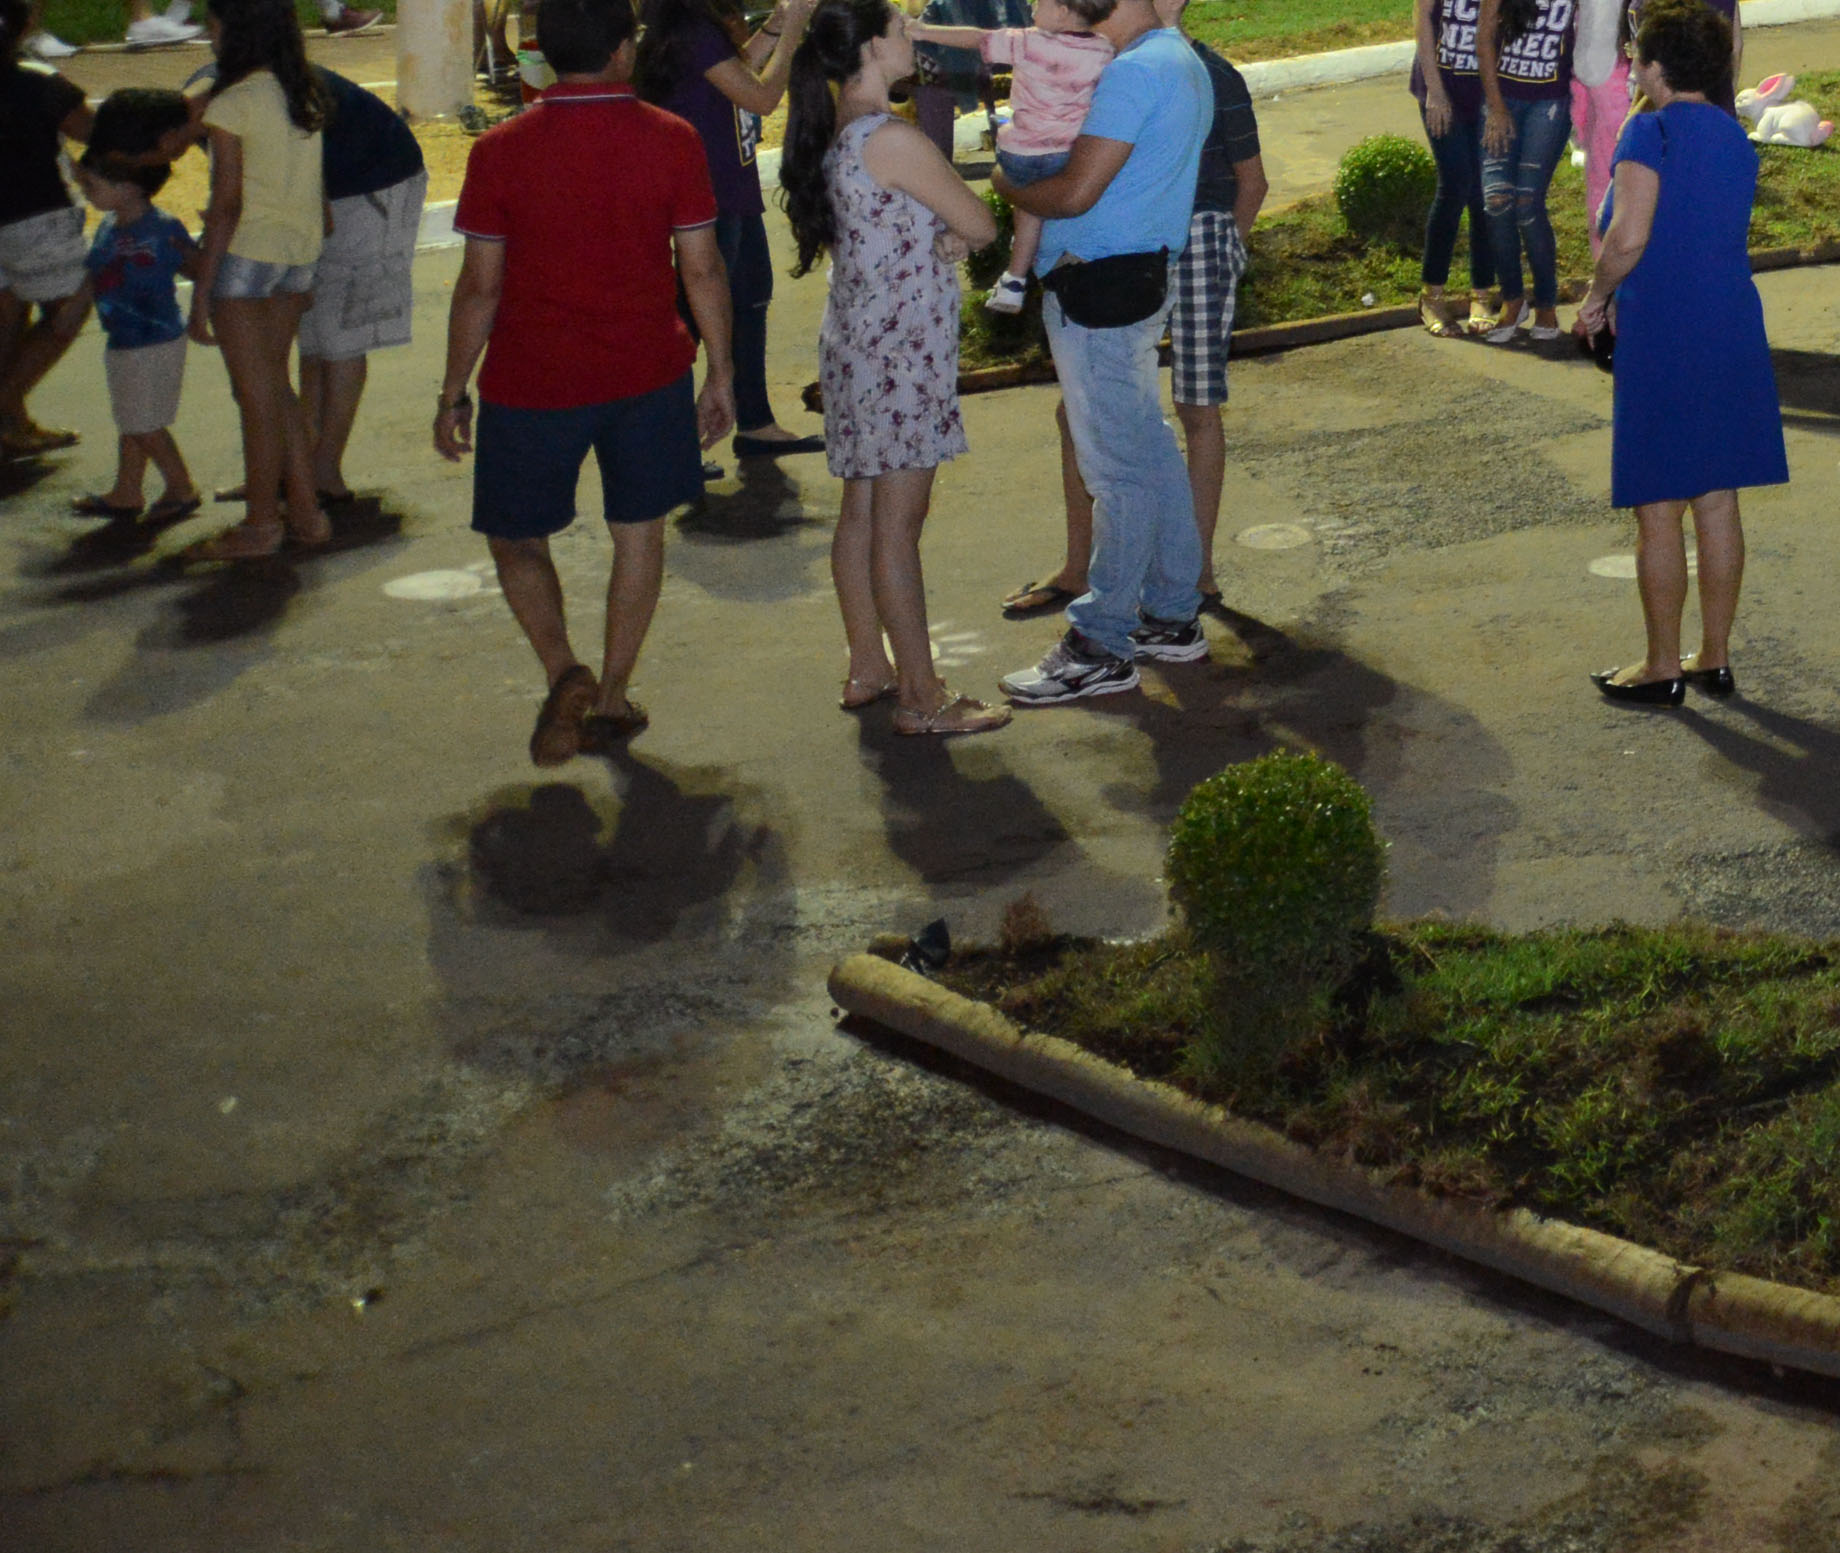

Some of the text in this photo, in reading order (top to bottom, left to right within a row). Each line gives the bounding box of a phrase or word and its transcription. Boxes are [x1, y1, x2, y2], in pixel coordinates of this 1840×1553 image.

[1440, 21, 1478, 52] NE
[1439, 47, 1479, 70] TEEN
[1500, 55, 1559, 78] TEENS
